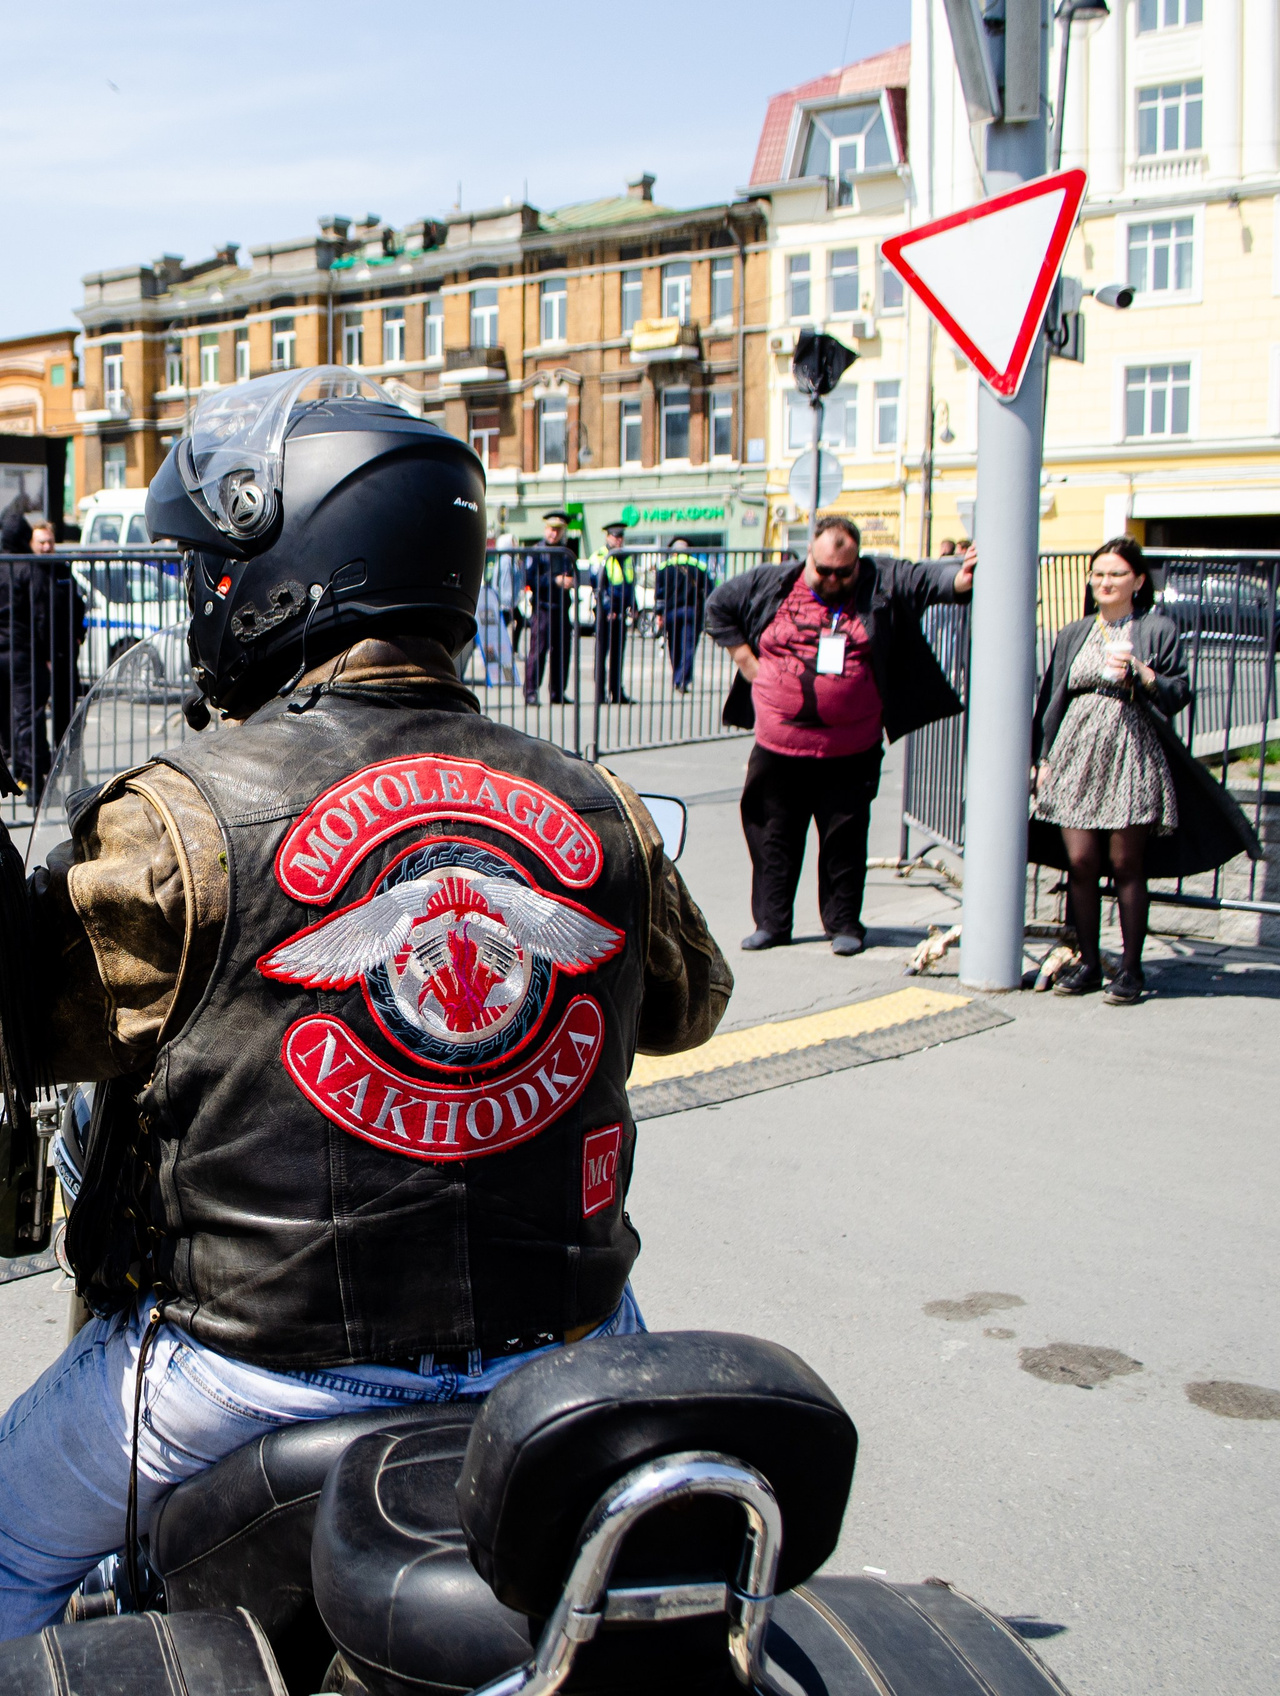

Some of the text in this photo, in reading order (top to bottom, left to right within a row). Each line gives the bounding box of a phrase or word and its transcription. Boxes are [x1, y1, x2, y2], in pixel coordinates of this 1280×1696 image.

[453, 496, 479, 513] Airoh
[289, 768, 593, 888] MOTOLEAGUE
[297, 1027, 596, 1145] NAKHODKA
[587, 1151, 615, 1190] MC
